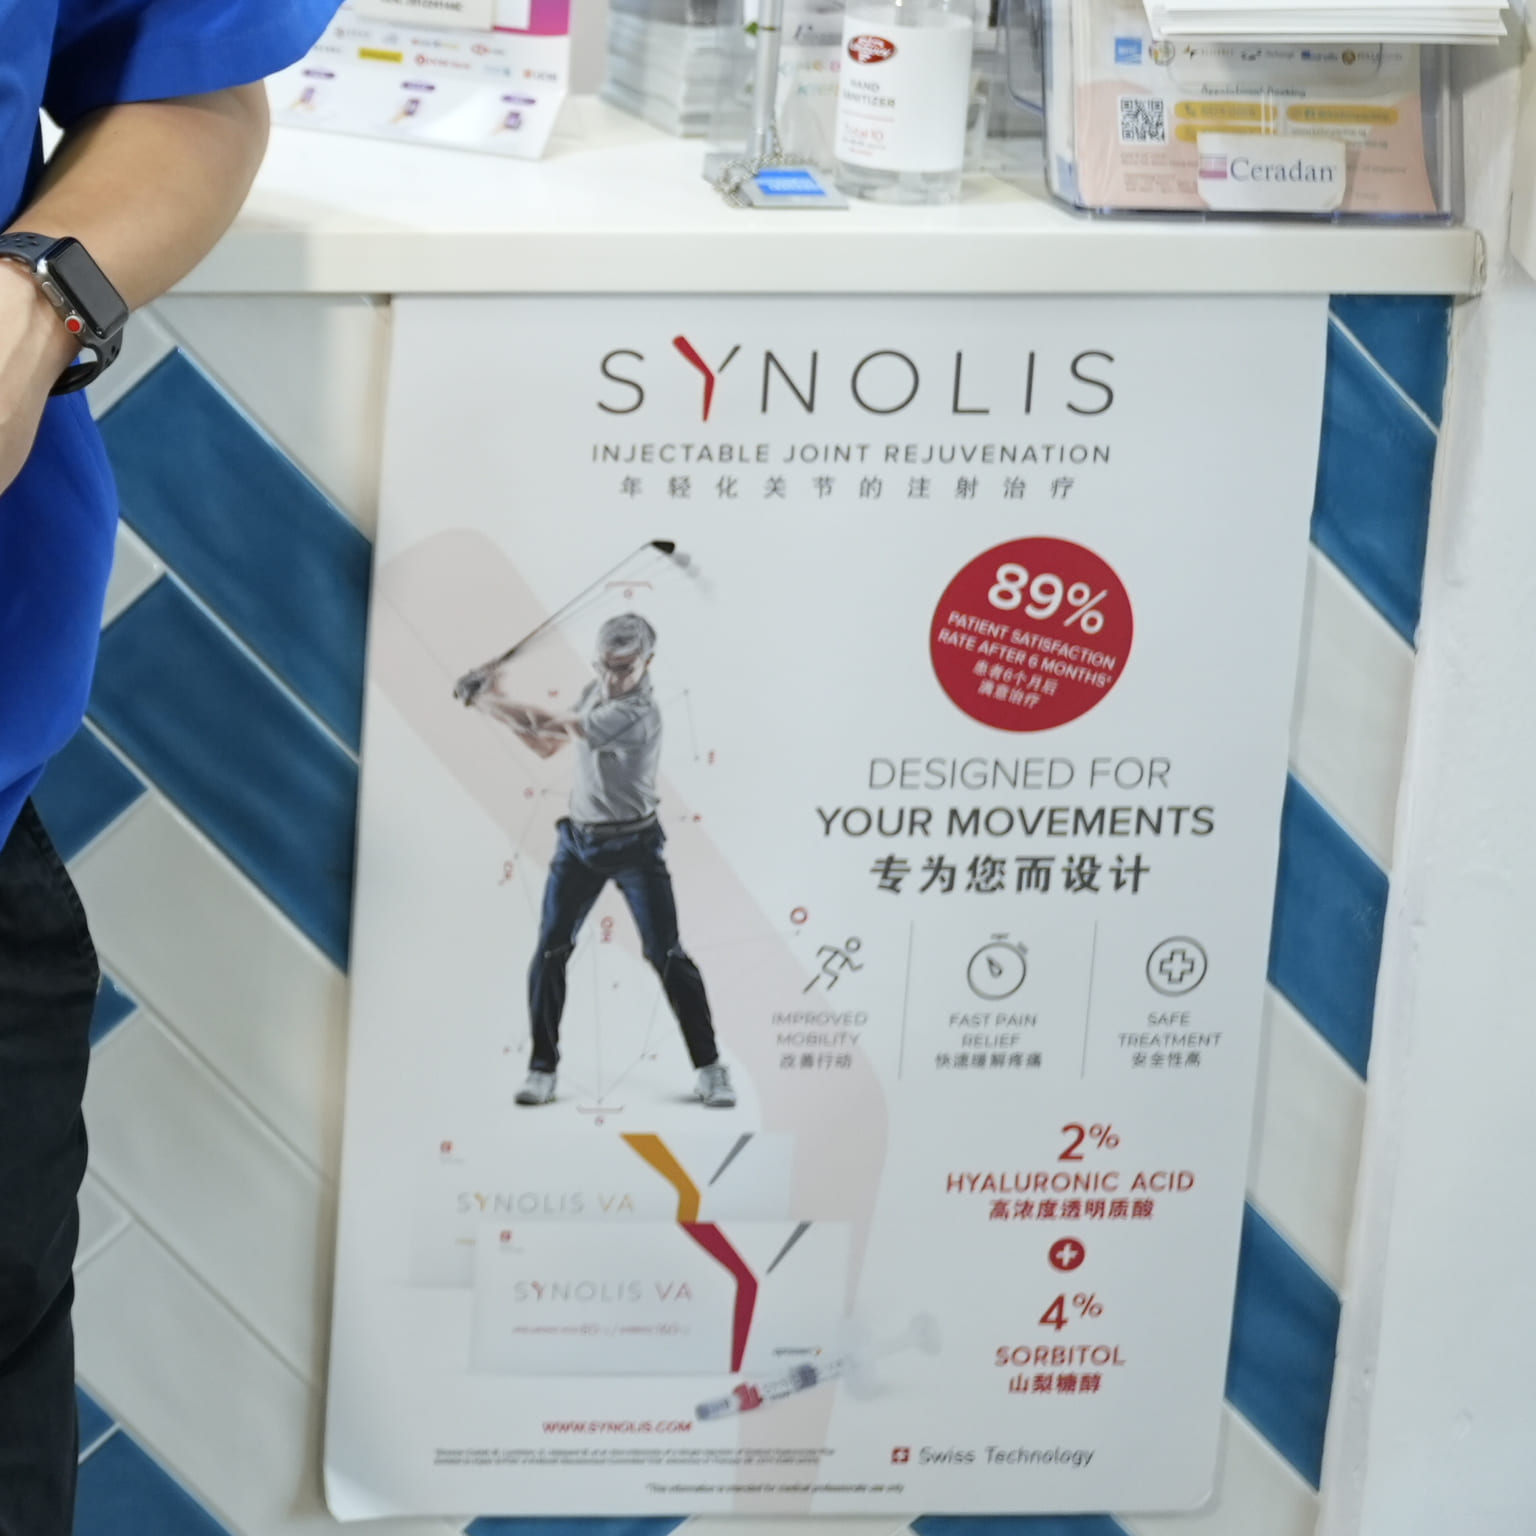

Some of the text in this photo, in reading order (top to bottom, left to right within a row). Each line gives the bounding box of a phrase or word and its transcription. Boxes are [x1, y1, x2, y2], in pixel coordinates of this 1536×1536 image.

[1230, 158, 1333, 183] Ceradan
[596, 334, 1116, 422] SYNOLIS
[591, 443, 1111, 465] INJECTABLE JOINT REJUVENATION
[618, 474, 1077, 500] 年轻化关节的注射治疗
[987, 562, 1109, 634] 89%
[938, 627, 975, 651] RATE
[977, 639, 1027, 665] AFTER
[1028, 654, 1039, 669] 6
[947, 610, 1117, 670] PATIENT SATISFACTION
[868, 757, 1172, 791] DESIGNED FOR
[815, 805, 1216, 837] YOUR MOVEMENTS
[869, 853, 1151, 895] 专为您而设计
[771, 1012, 868, 1027] IMPROVED
[949, 1013, 1038, 1027] FAST PAIN
[1147, 1012, 1191, 1026] SAFE
[776, 1033, 860, 1047] MOBILITY
[961, 1033, 1021, 1047] RELIEF
[1118, 1033, 1223, 1047] TREATMENT
[1057, 1121, 1120, 1162] 2%
[946, 1171, 1195, 1194] HYALURONIC ACID
[456, 1191, 634, 1214] SYNOLIS VA
[988, 1198, 1155, 1221] 高浓度透明质酸
[514, 1280, 692, 1303] SYNOLIS VA
[1038, 1292, 1104, 1332] 4%
[994, 1345, 1126, 1367] SORBITOL
[542, 1420, 693, 1434] WWW.SYNOLIS.COM
[918, 1446, 1096, 1468] Swiss Technology
